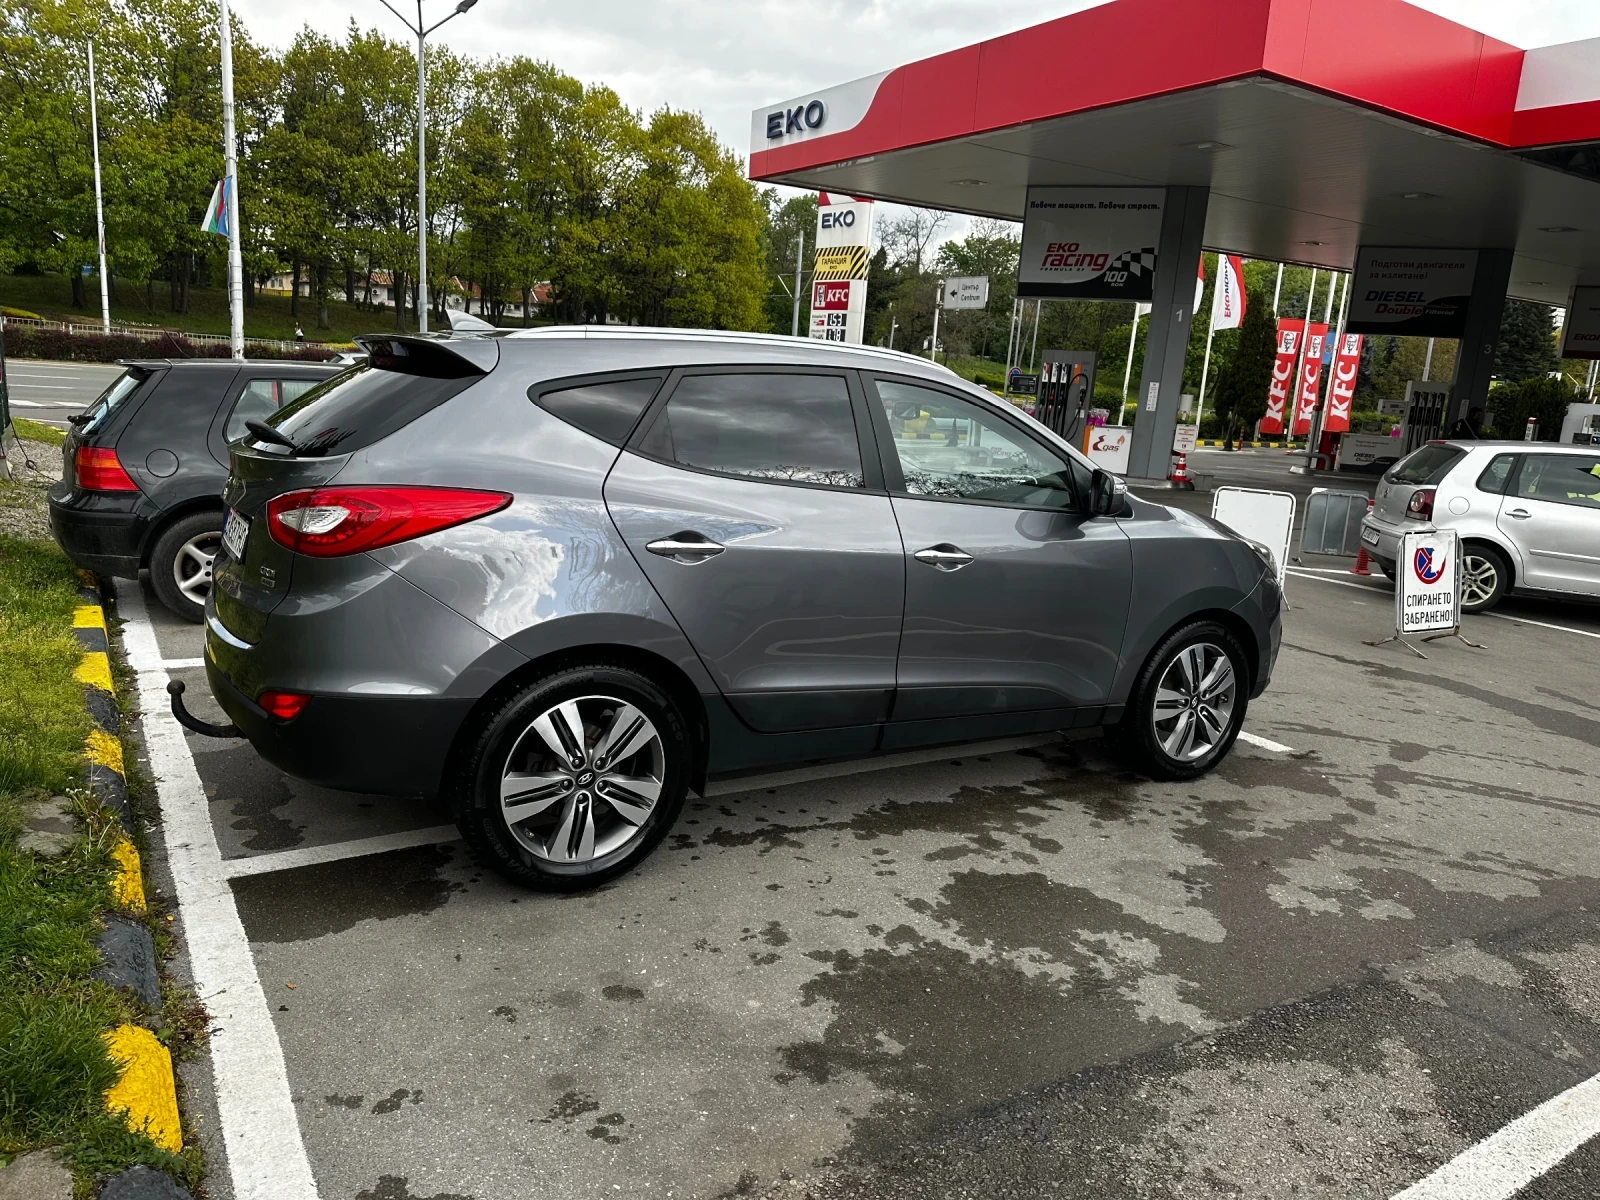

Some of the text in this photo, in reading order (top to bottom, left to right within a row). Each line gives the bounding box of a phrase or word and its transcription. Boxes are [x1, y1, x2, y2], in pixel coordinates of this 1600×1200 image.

[767, 99, 824, 138] EKO
[1030, 200, 1160, 211] Повече мощност. Повече страст.
[821, 209, 855, 229] EKO
[1046, 242, 1080, 252] EKO
[821, 257, 847, 266] ГАРАНЦИЯ
[1041, 253, 1110, 272] racing
[1371, 260, 1465, 270] Подготви двигателя
[1103, 271, 1129, 283] 100
[1381, 272, 1428, 280] излитане!
[826, 288, 849, 303] KFC
[1365, 290, 1426, 302] DIESEL
[1176, 309, 1183, 322] 1
[1375, 303, 1455, 316] Double Filtered
[1483, 343, 1492, 355] 3
[1266, 359, 1291, 422] KFC
[1299, 363, 1318, 420] KFC
[1330, 361, 1356, 420] KFC
[1406, 592, 1452, 607] СПИРАНЕТО
[1404, 609, 1453, 625] ЗАБРАНЕНО!
